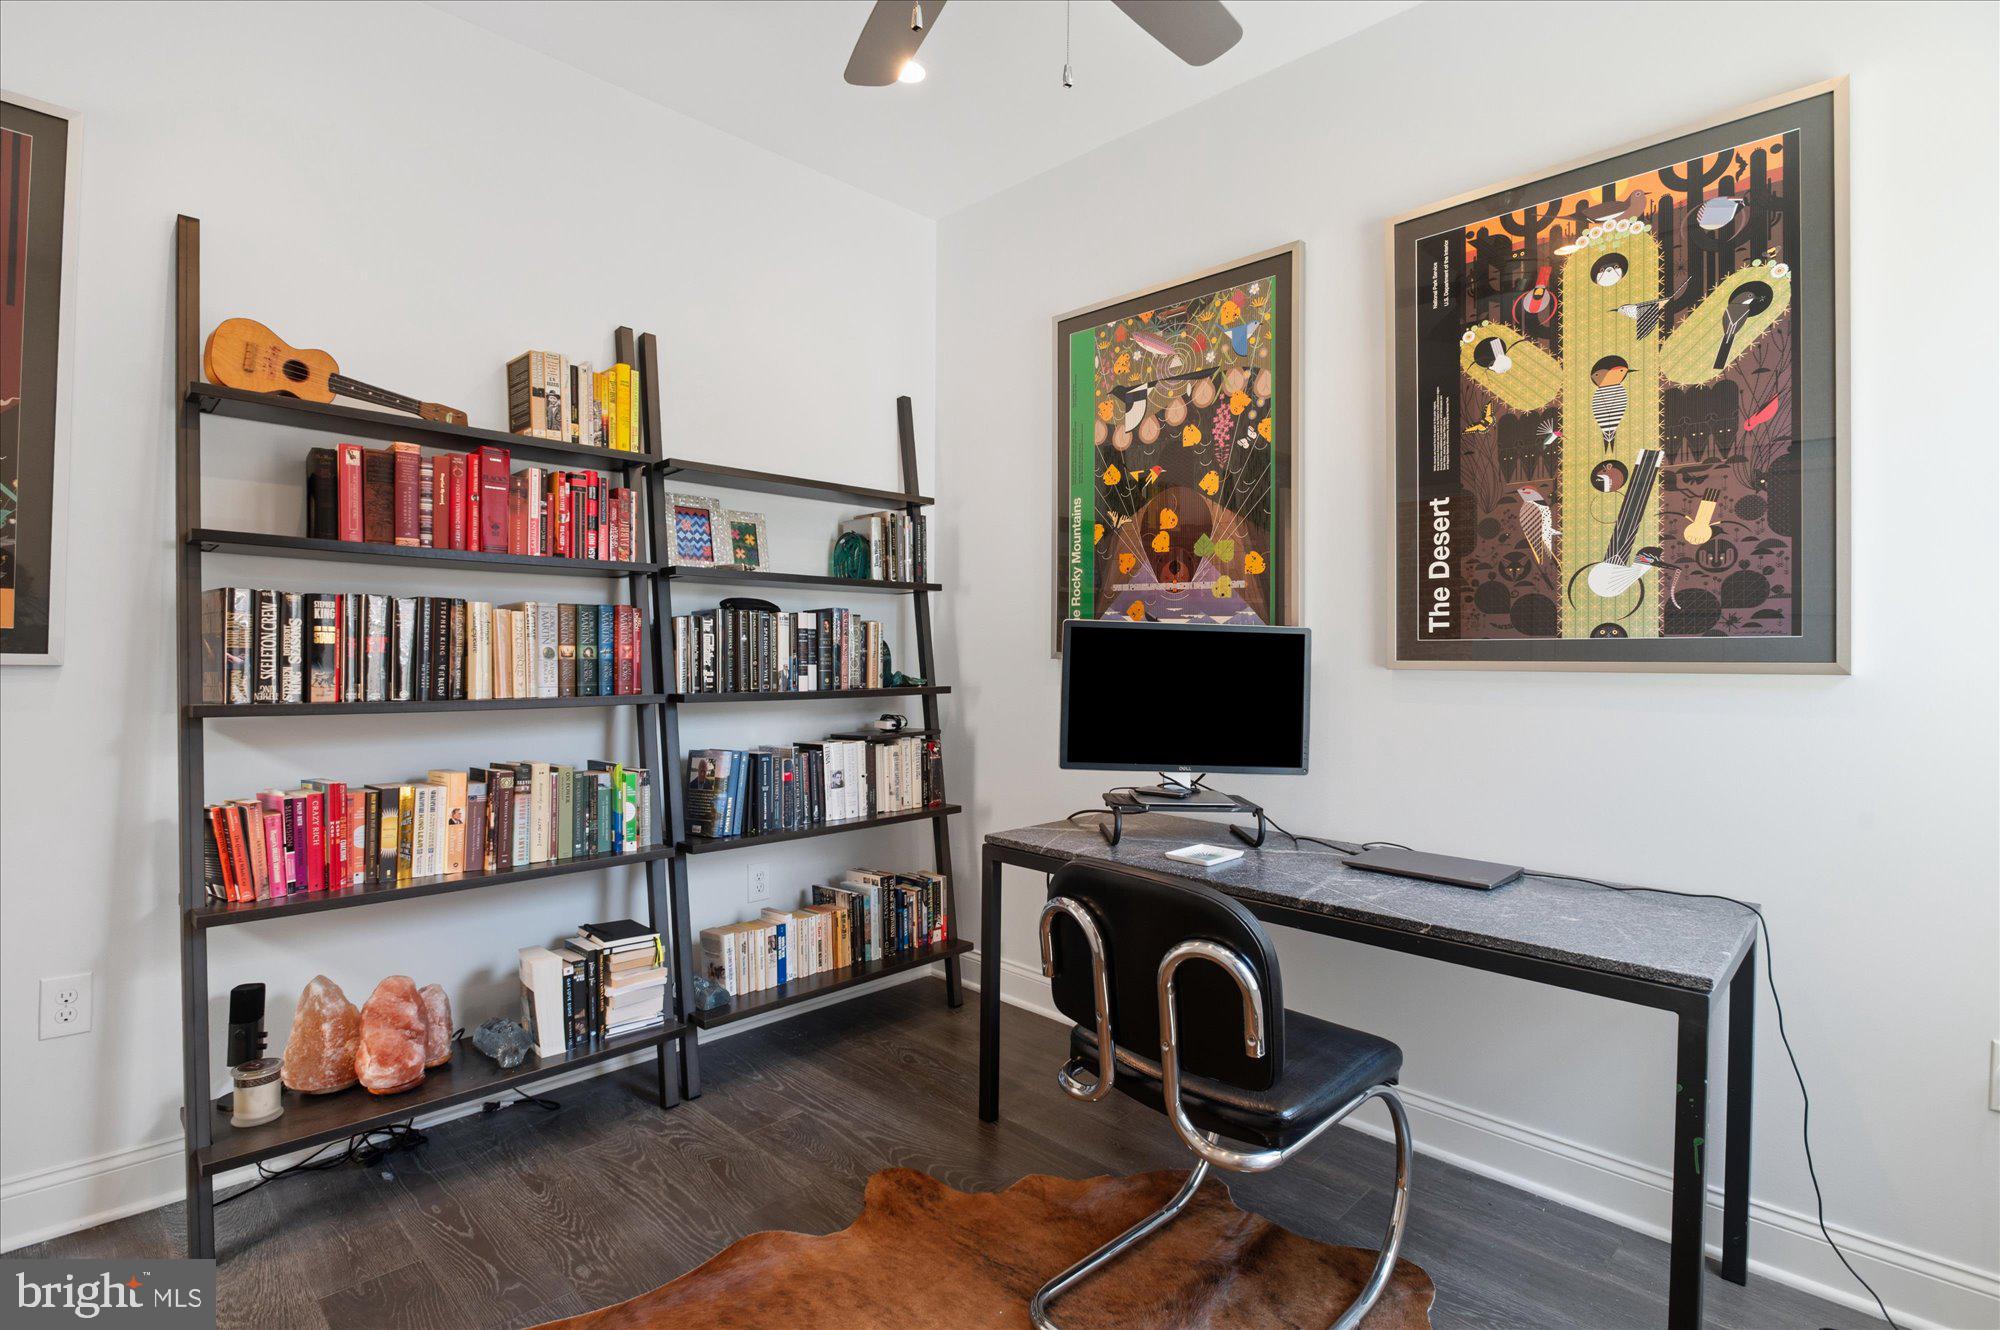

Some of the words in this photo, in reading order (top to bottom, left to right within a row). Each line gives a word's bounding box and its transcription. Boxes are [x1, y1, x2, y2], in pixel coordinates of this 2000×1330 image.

[1072, 497, 1081, 563] Mountains
[1429, 497, 1450, 579] Desert
[588, 546, 596, 559] ASK
[1072, 567, 1082, 606] Rocky
[260, 602, 277, 631] CREW
[314, 608, 335, 619] KING
[542, 610, 550, 645] MARTIN
[561, 610, 569, 645] MARTIN
[581, 610, 589, 645] MARTIN
[602, 610, 610, 644] MARTIN
[620, 610, 628, 644] MARTIN
[703, 618, 713, 632] The
[1429, 587, 1450, 633] The
[260, 632, 277, 680] SKELETON
[289, 618, 302, 664] SEASONS
[703, 633, 715, 666] Godfather
[283, 666, 292, 701] STEPHEN
[291, 671, 302, 695] KING
[285, 804, 294, 847] SELLEVISION
[311, 800, 319, 825] CRAZY
[312, 827, 320, 846] RICH
